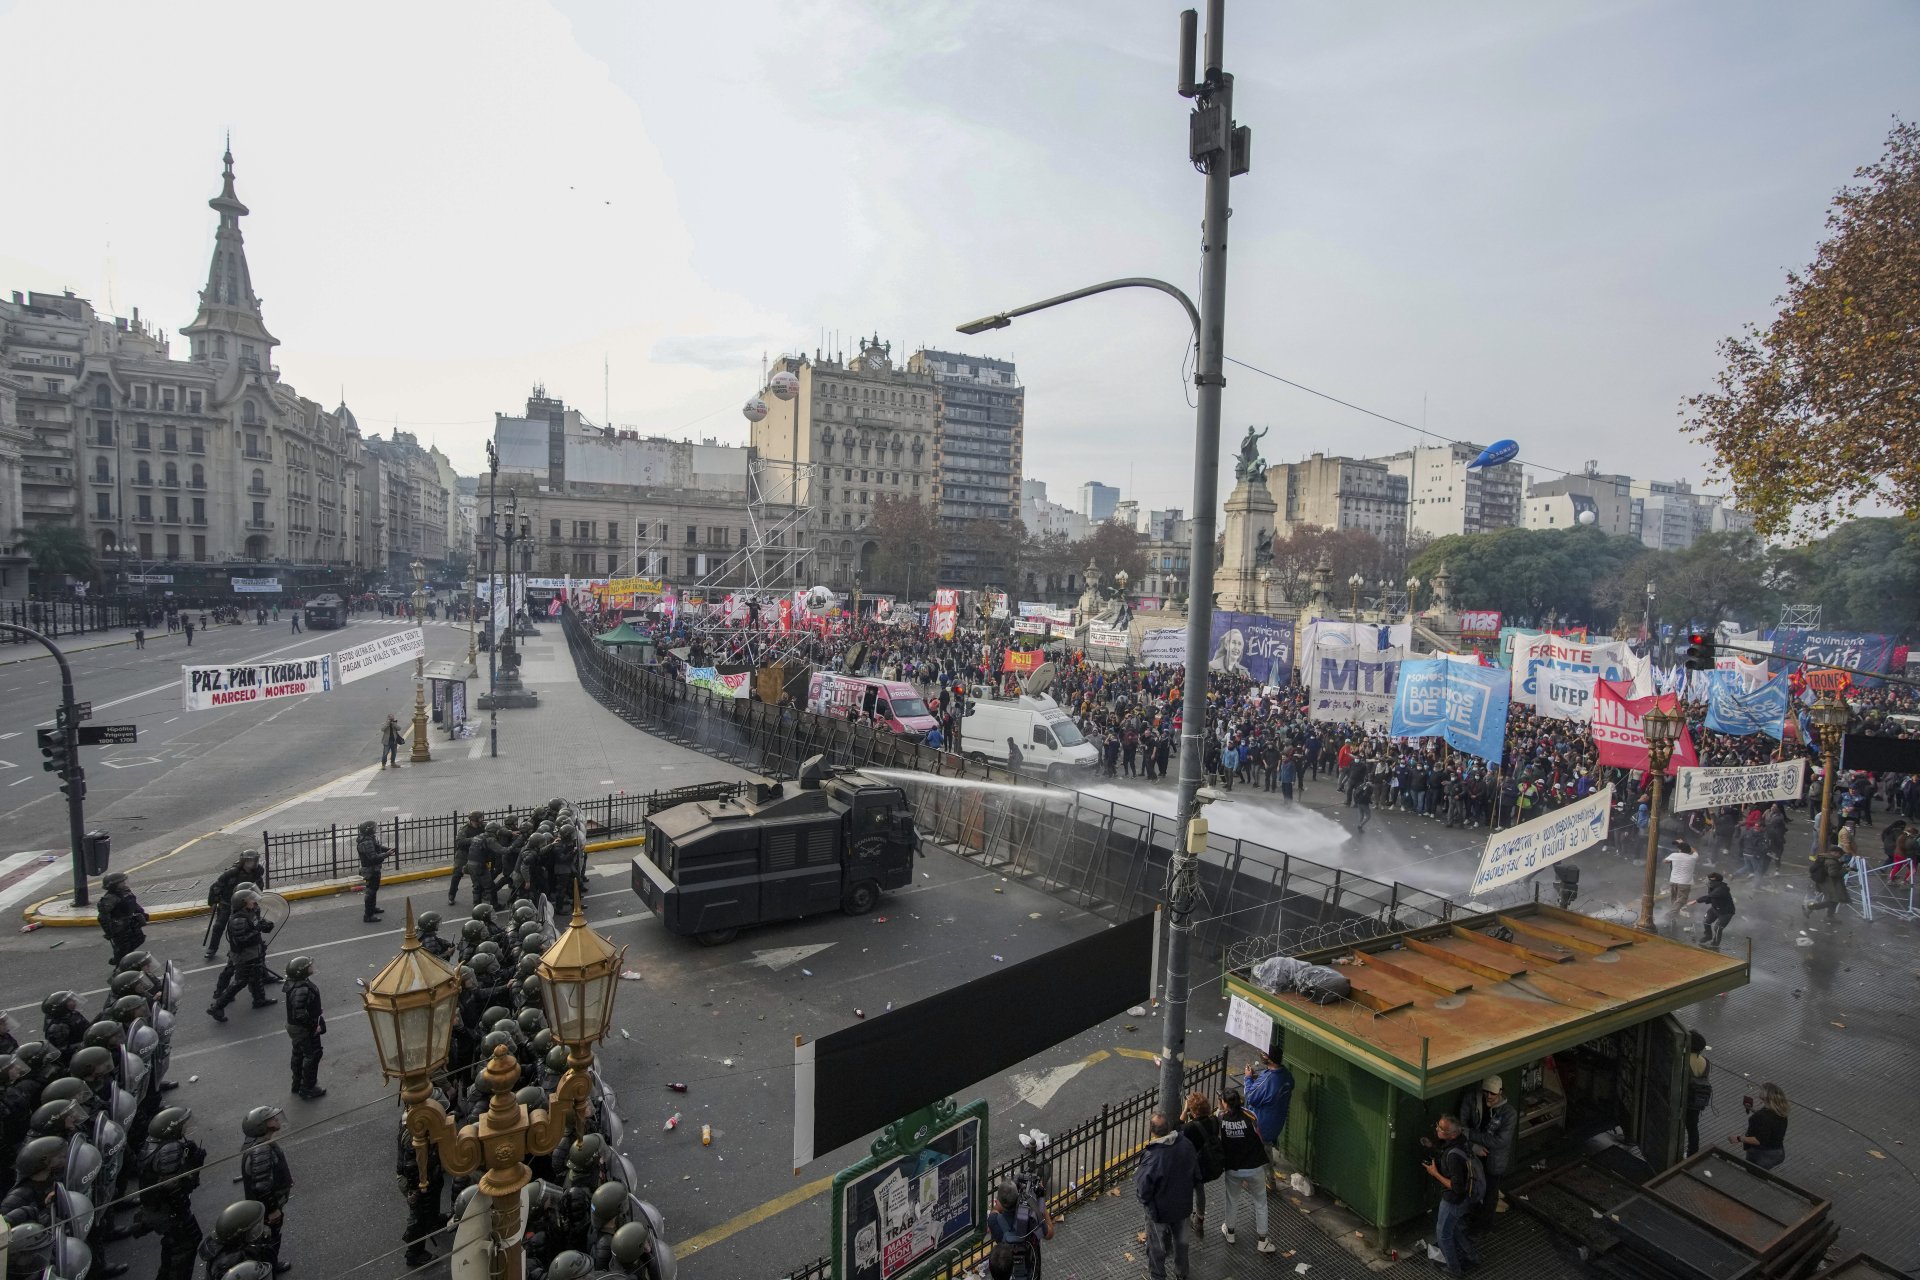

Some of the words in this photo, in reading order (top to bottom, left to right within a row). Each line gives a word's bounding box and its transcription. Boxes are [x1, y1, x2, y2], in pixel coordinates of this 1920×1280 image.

[382, 635, 404, 648] NUESTRA
[1246, 636, 1289, 664] Evita
[362, 656, 372, 667] LOS
[1529, 644, 1593, 663] FRENTE
[259, 660, 317, 685] TRABAJO
[211, 688, 256, 706] MARCELO
[265, 682, 306, 698] MONTERO
[1549, 683, 1589, 707] UTEP
[1409, 699, 1439, 716] DE
[1221, 1119, 1248, 1131] PRENSA
